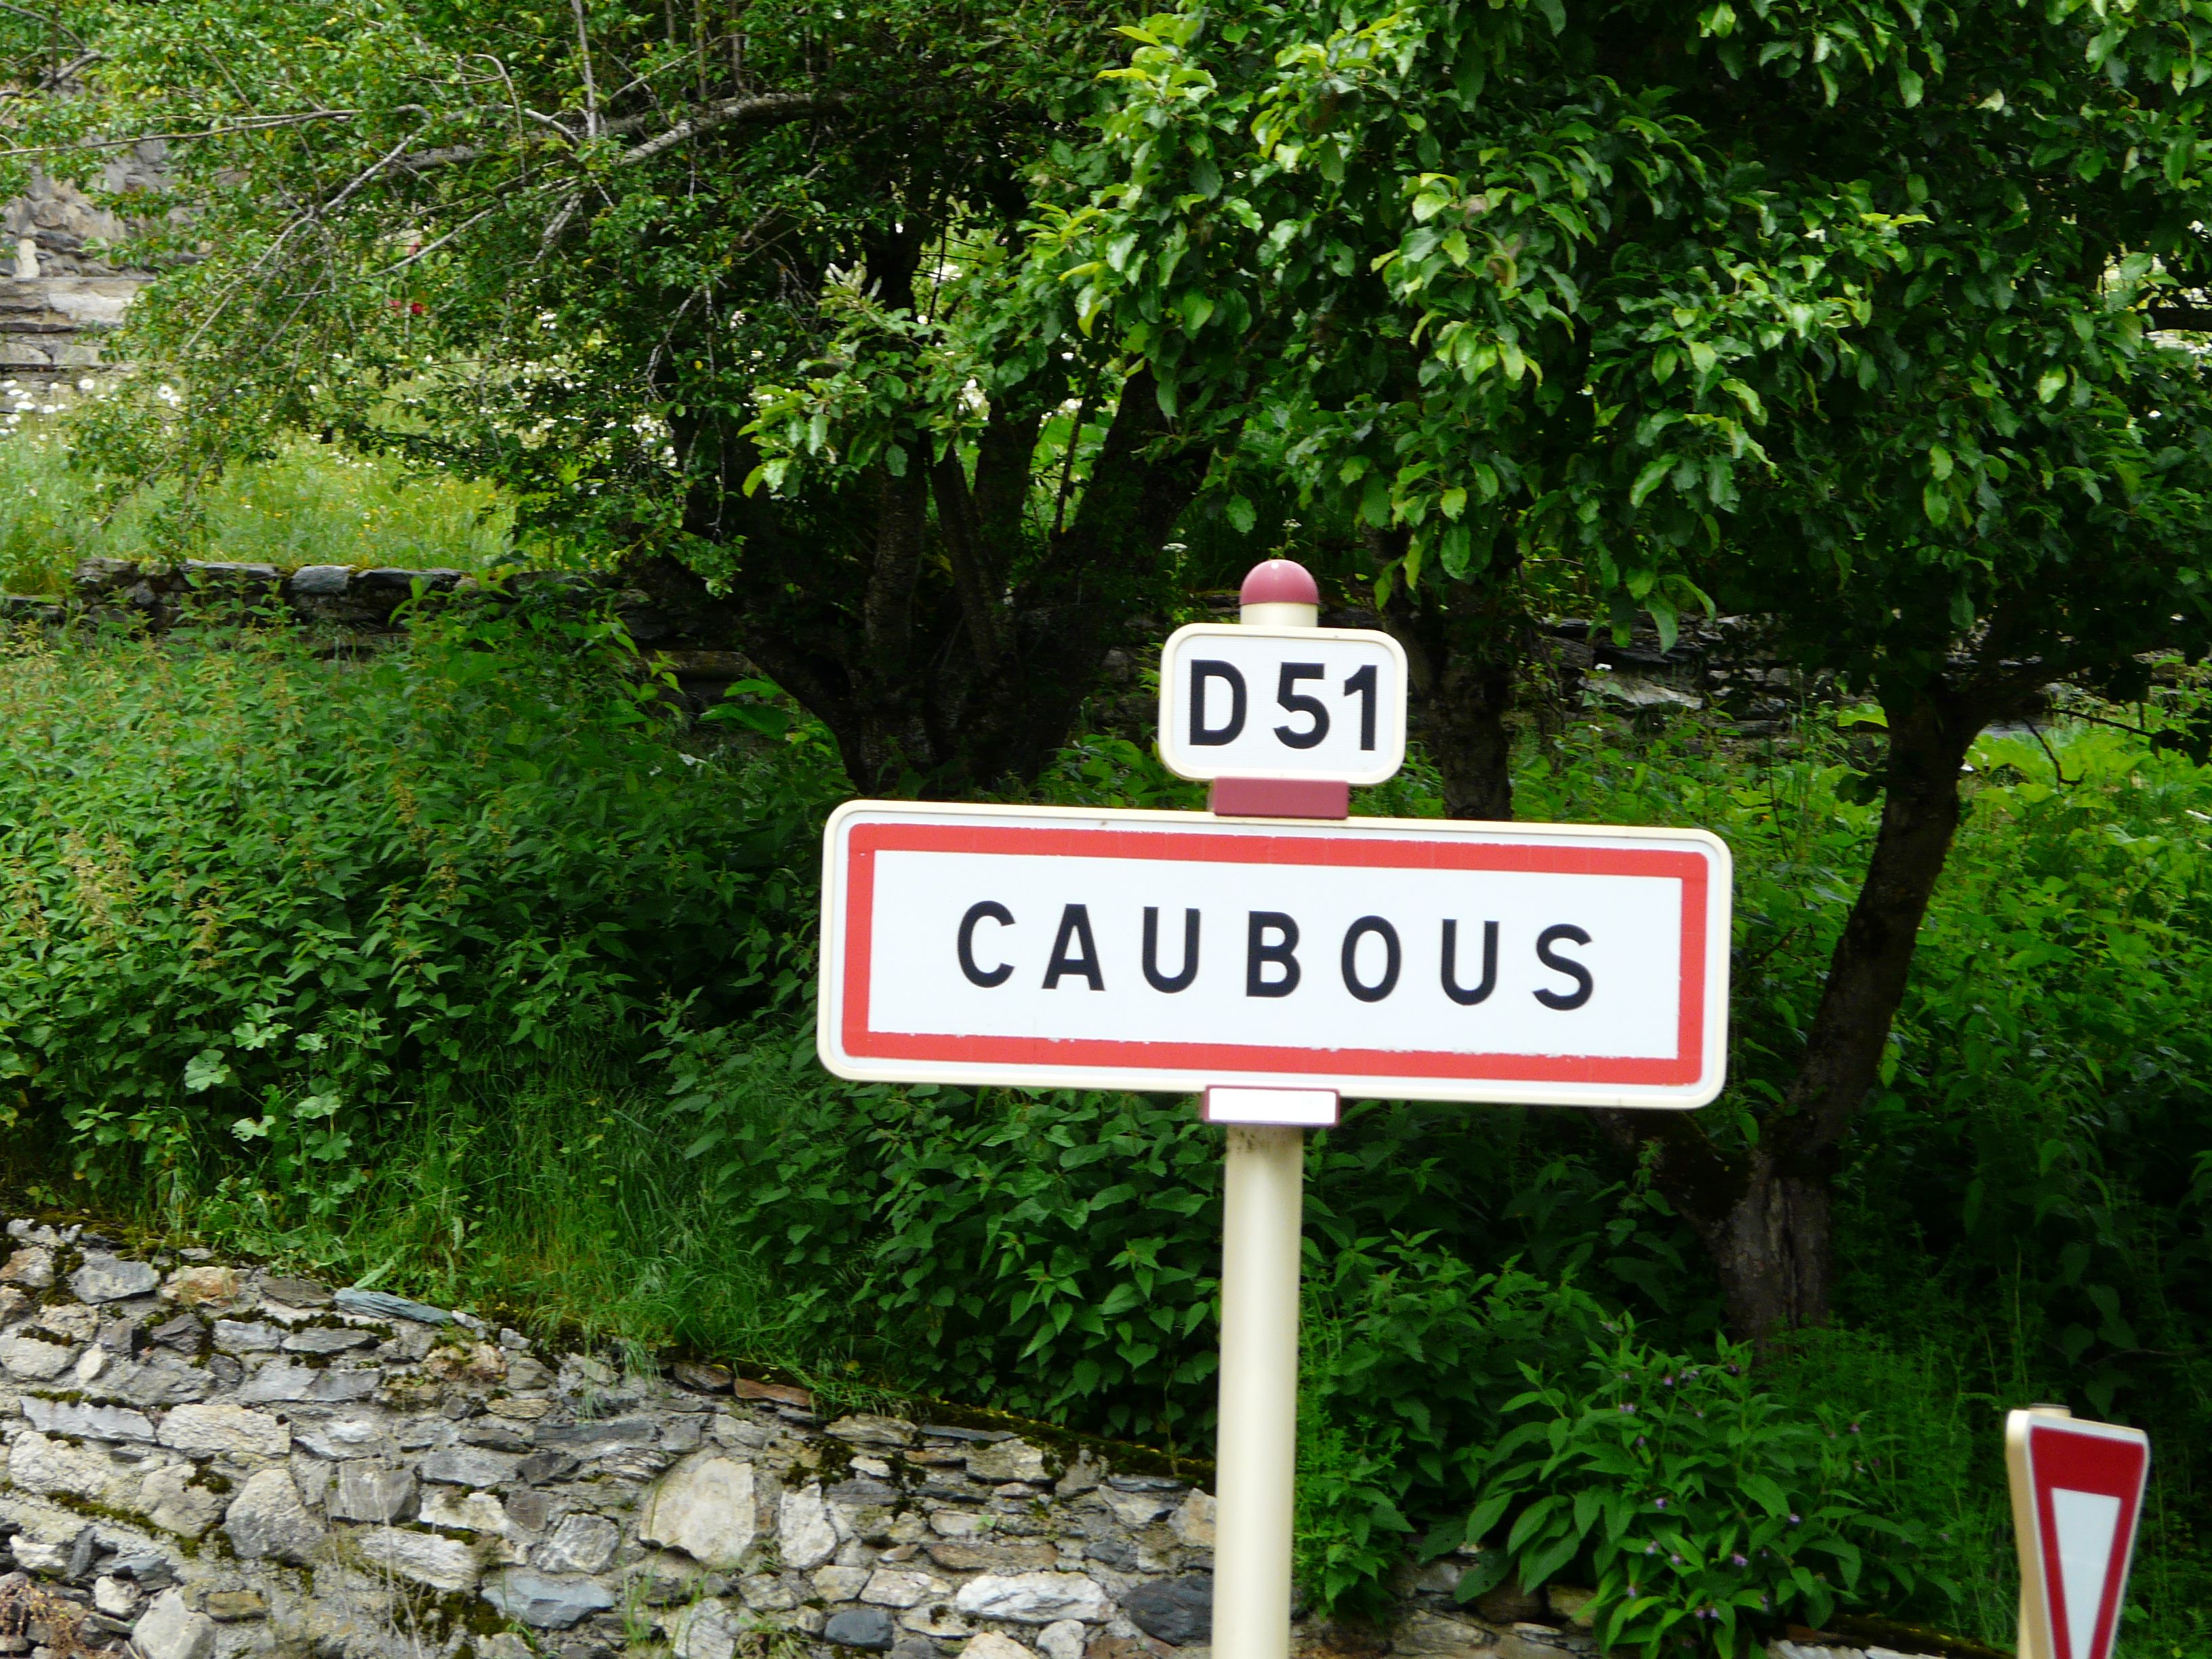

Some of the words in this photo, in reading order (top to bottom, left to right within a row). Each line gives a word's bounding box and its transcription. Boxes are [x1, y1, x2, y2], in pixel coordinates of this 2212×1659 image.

[1189, 659, 1248, 747] D
[1273, 661, 1377, 752] 51
[957, 900, 1593, 1011] CAUBOUS
